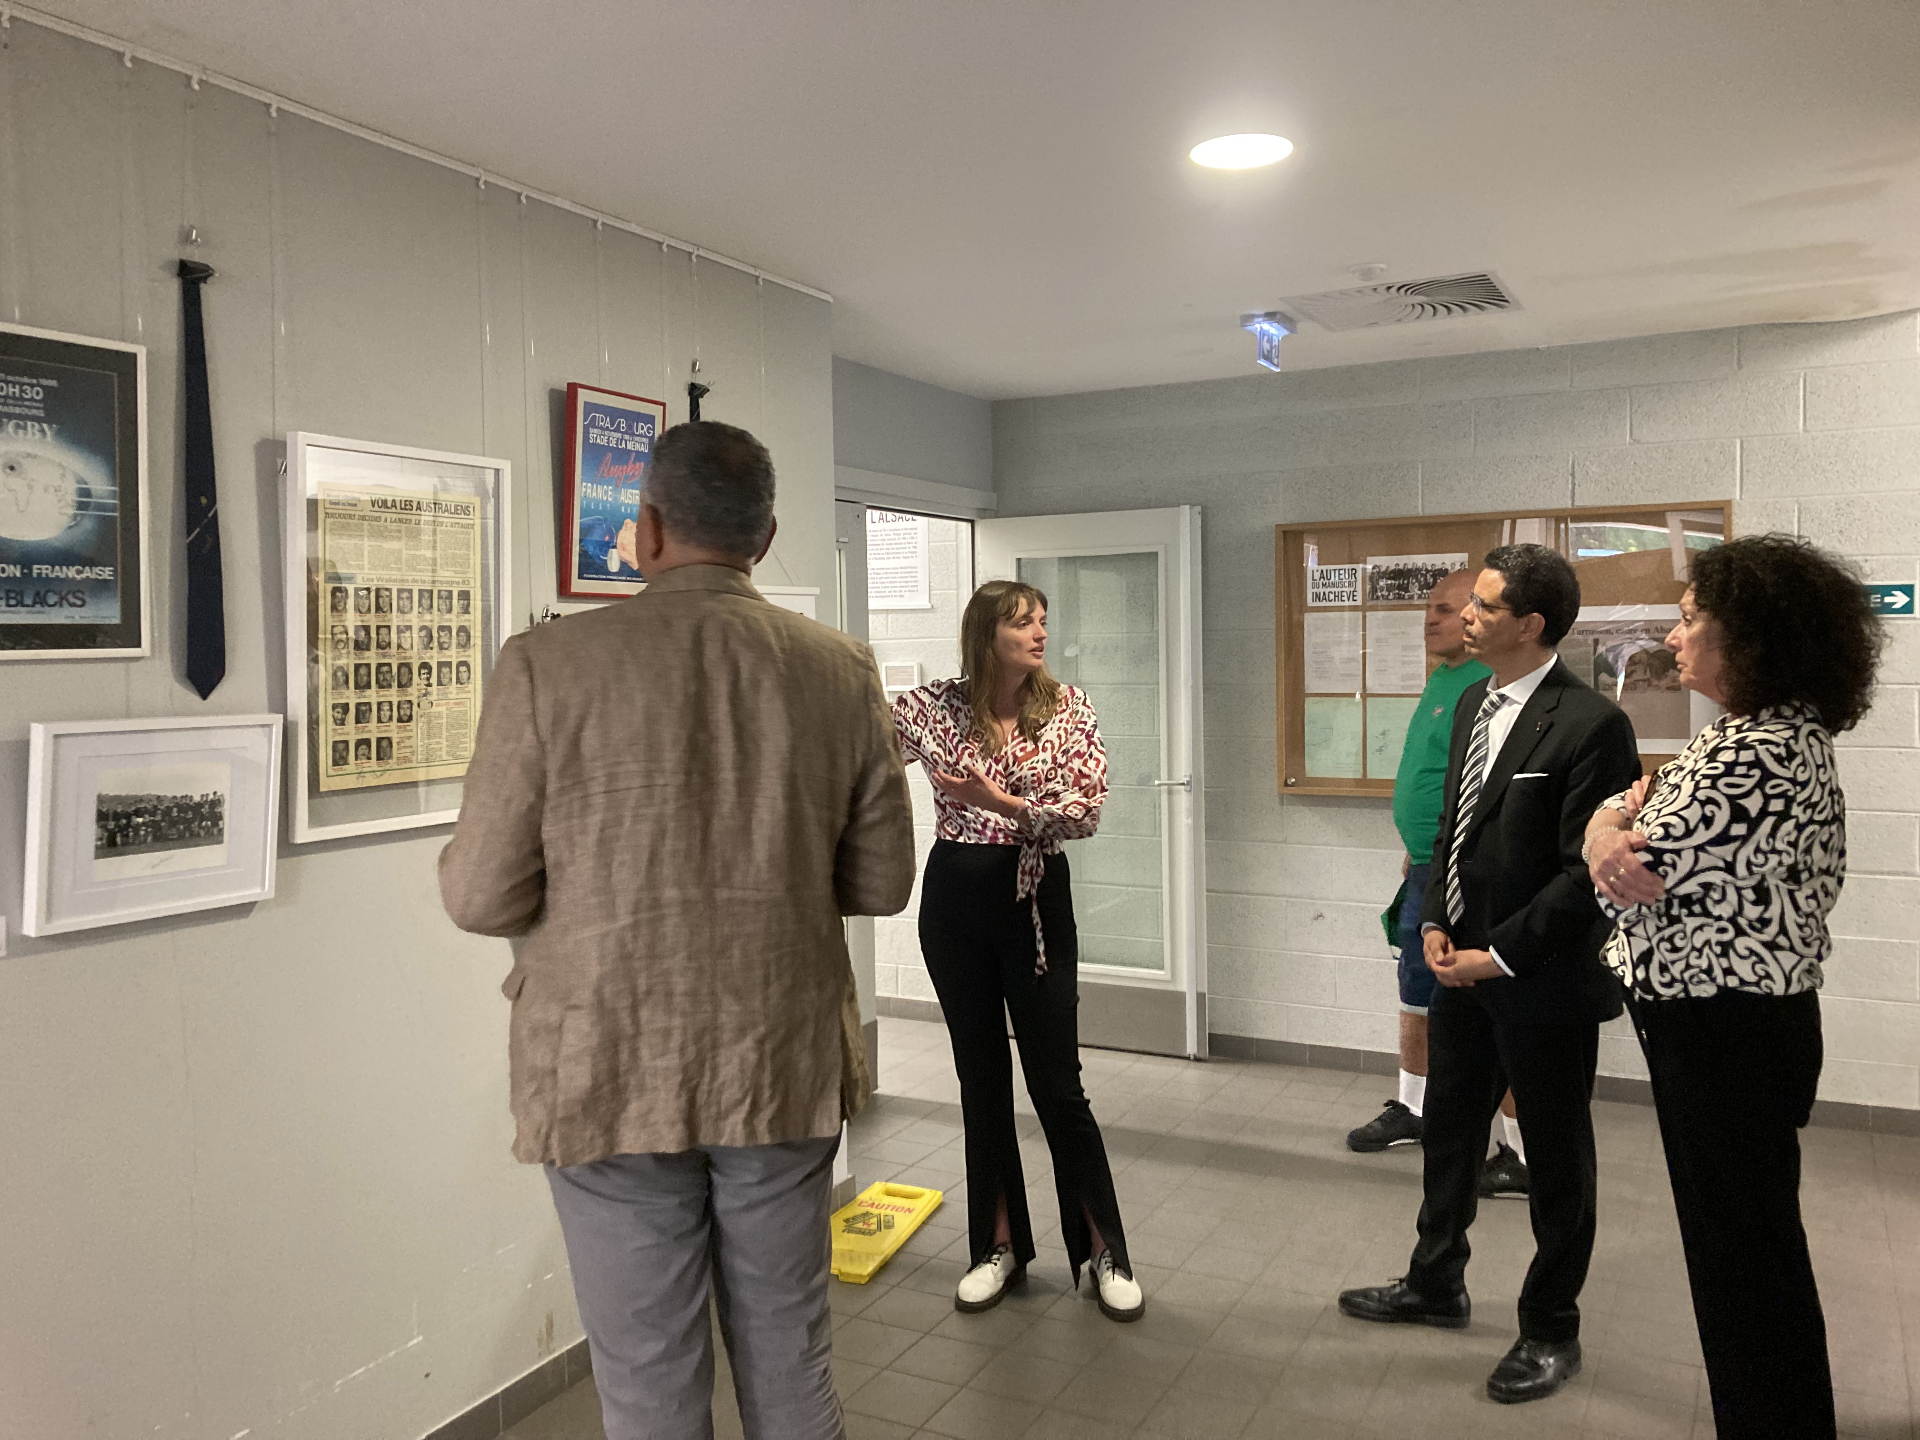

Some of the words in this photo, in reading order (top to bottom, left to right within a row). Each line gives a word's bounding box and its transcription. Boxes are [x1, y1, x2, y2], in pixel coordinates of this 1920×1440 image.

[584, 413, 653, 436] STRASBOURG
[589, 433, 608, 446] STADE
[609, 437, 617, 448] DE
[618, 439, 626, 449] LA
[627, 440, 649, 453] MEINAU
[582, 482, 613, 501] FRANCE
[370, 497, 398, 510] VOILA
[400, 499, 414, 511] LES
[415, 501, 471, 516] AUSTRALIENS
[32, 564, 115, 581] FRANÇAISE
[1311, 568, 1358, 581] L'AUTEUR
[1311, 581, 1320, 590] DU
[1321, 580, 1357, 590] MANUSCRIT
[1311, 589, 1358, 603] INACHEVÉ
[857, 1200, 915, 1214] CAUTION
